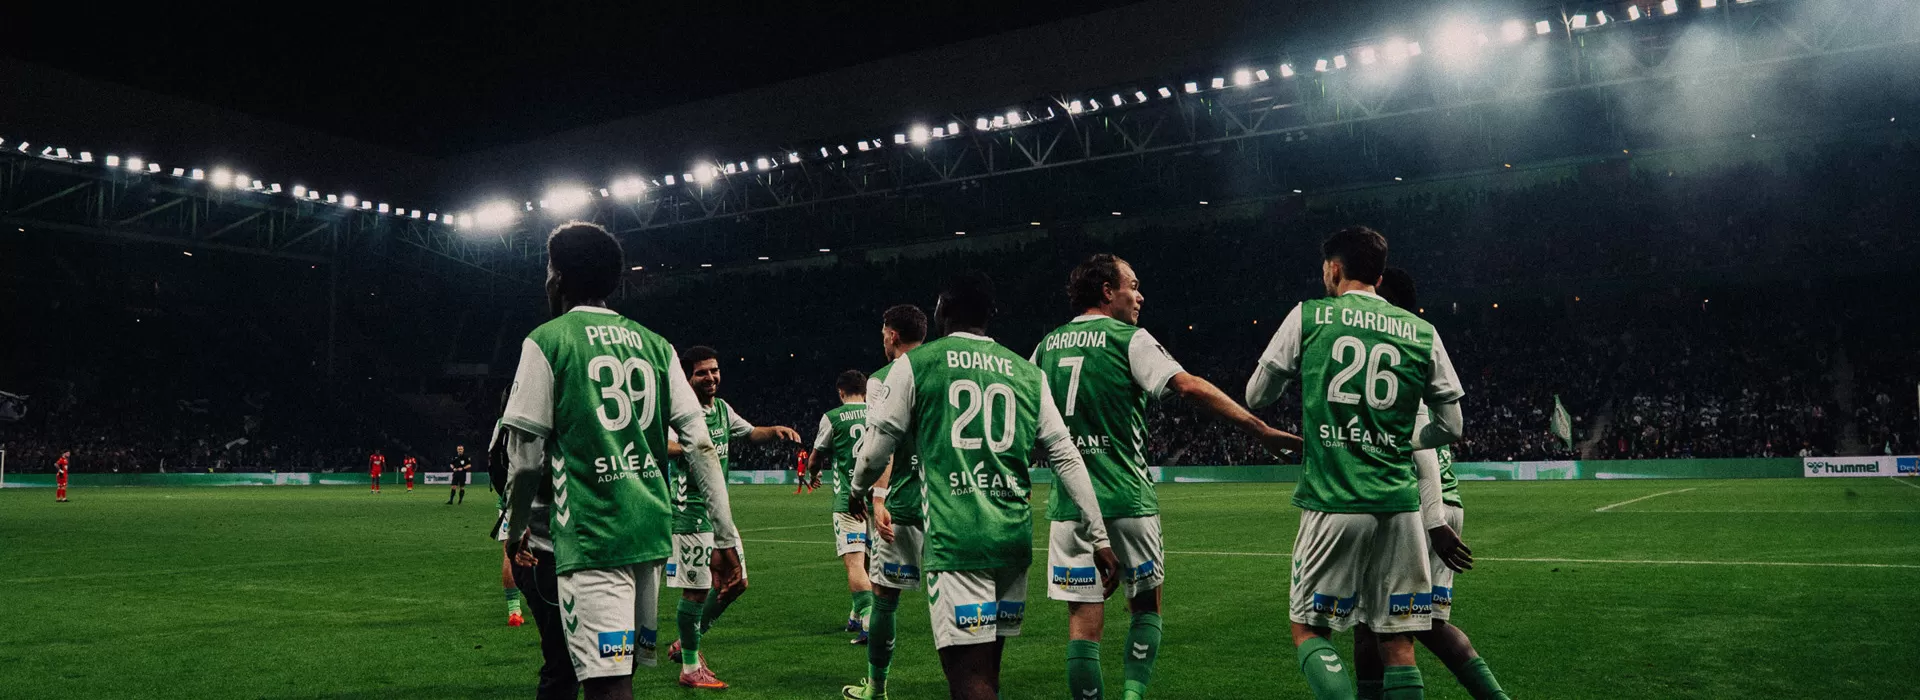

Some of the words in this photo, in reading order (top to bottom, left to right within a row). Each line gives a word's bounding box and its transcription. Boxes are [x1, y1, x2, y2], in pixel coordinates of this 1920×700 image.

[585, 325, 643, 350] PEDRO
[1046, 331, 1107, 352] CARDONA
[1315, 306, 1333, 325] LE
[1341, 308, 1421, 343] CARDINAL
[946, 350, 1014, 377] BOAKYE
[1327, 335, 1401, 410] 26
[587, 355, 656, 431] 39
[1058, 355, 1084, 416] 7
[948, 379, 1016, 453] 20
[594, 441, 659, 473] SILÉA
[1825, 461, 1879, 473] hummel
